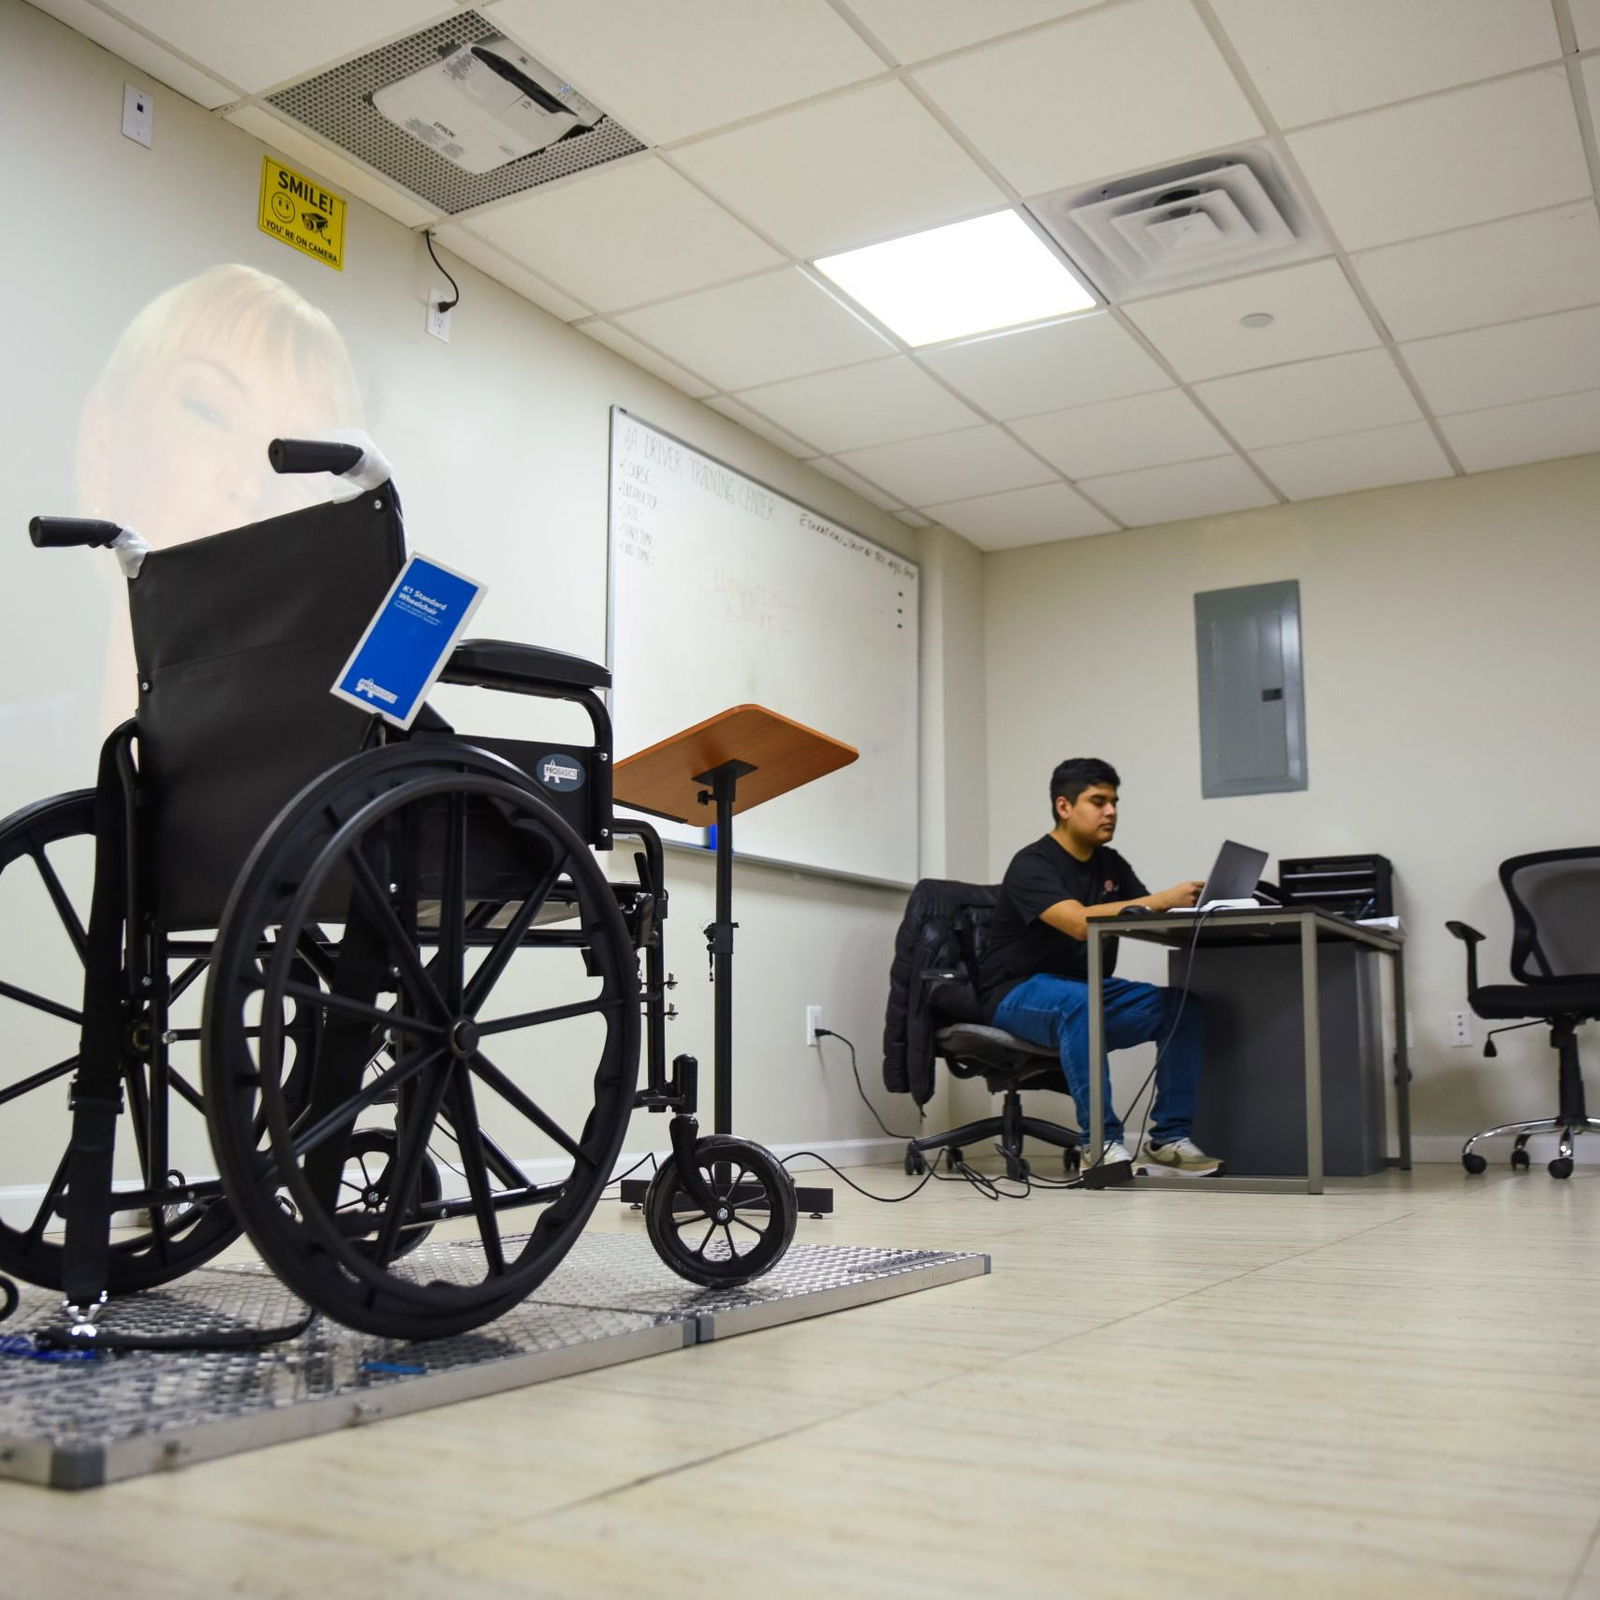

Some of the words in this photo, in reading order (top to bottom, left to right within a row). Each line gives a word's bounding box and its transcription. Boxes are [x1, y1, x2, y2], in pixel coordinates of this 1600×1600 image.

[278, 170, 334, 216] SMILE!
[296, 236, 307, 247] ON
[308, 242, 338, 263] CAMERA
[644, 434, 682, 477] DRIVER
[689, 457, 735, 506] TRAINING
[739, 483, 776, 523] CENTER
[398, 592, 438, 615] Wheelchair
[402, 585, 414, 595] K1
[414, 590, 448, 611] Standard
